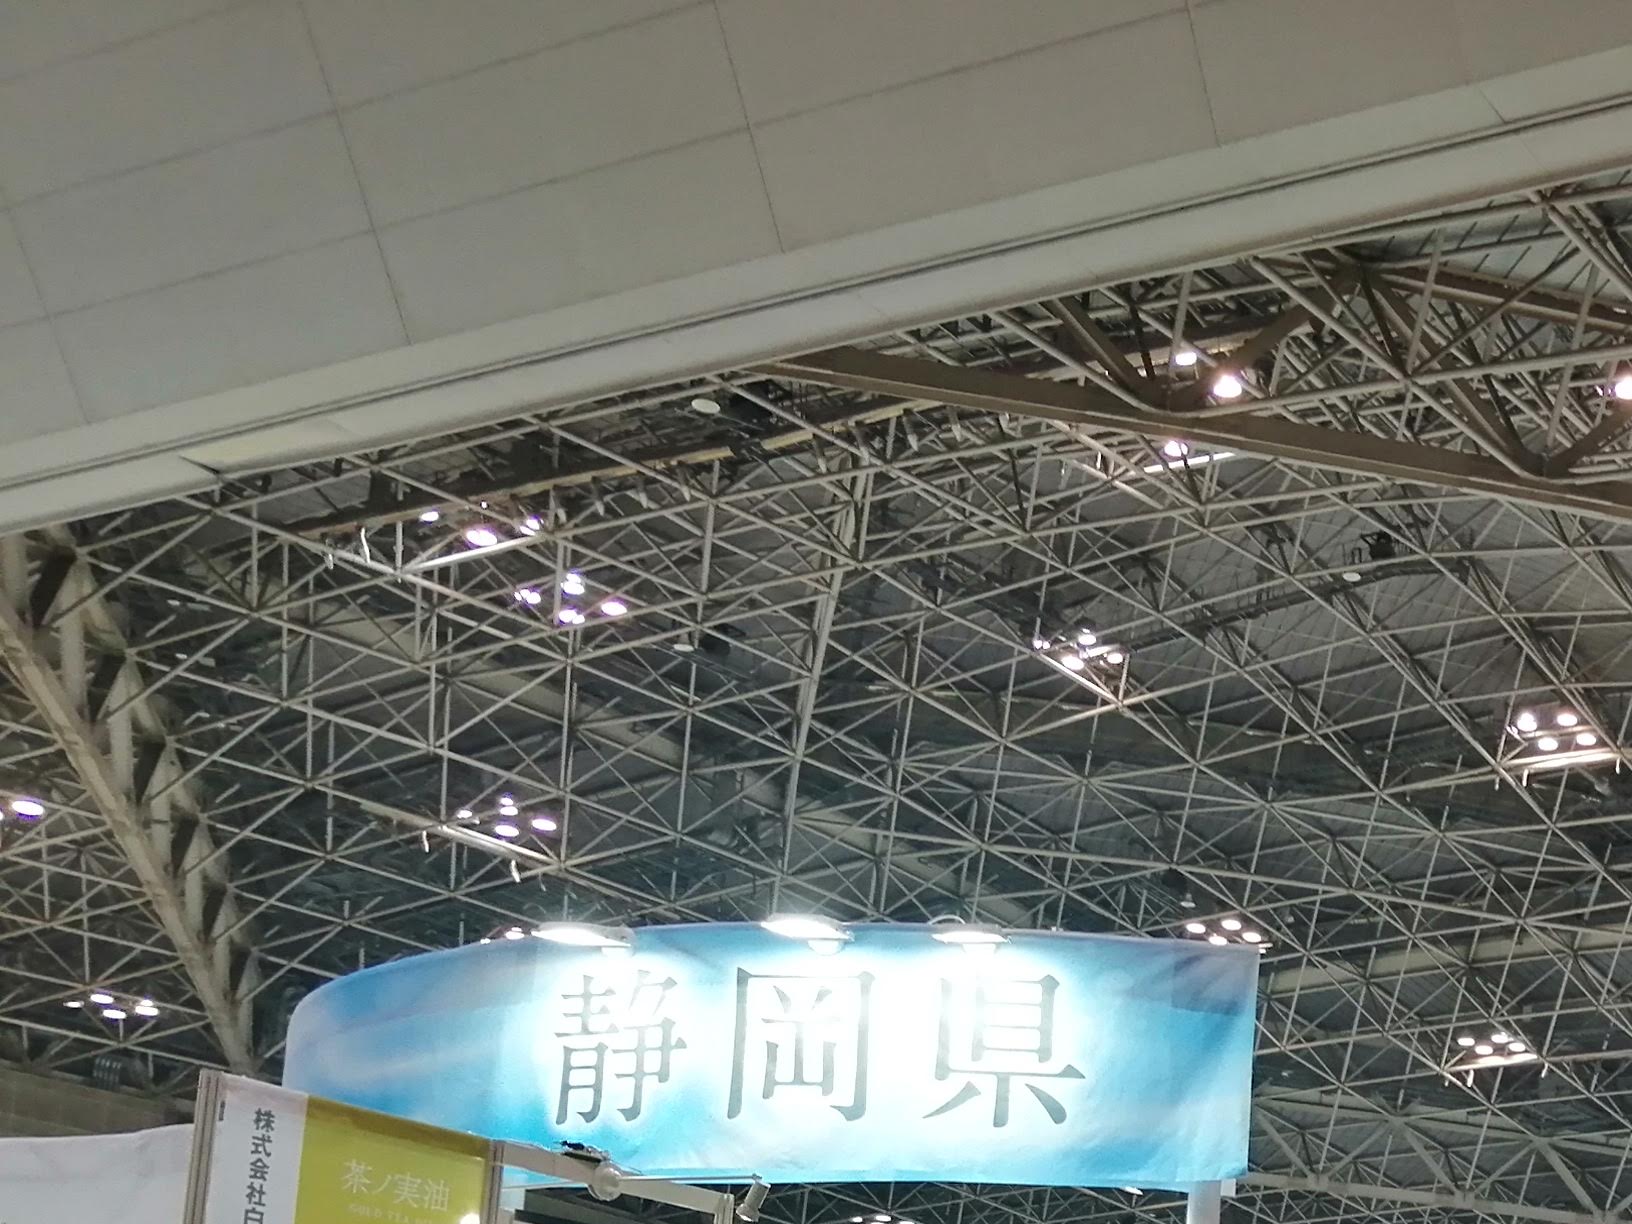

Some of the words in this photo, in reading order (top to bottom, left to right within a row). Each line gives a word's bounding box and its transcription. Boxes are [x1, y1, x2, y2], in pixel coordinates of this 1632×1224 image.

[555, 967, 1086, 1128] 静岡県
[341, 1159, 450, 1212] 茶ノ実油
